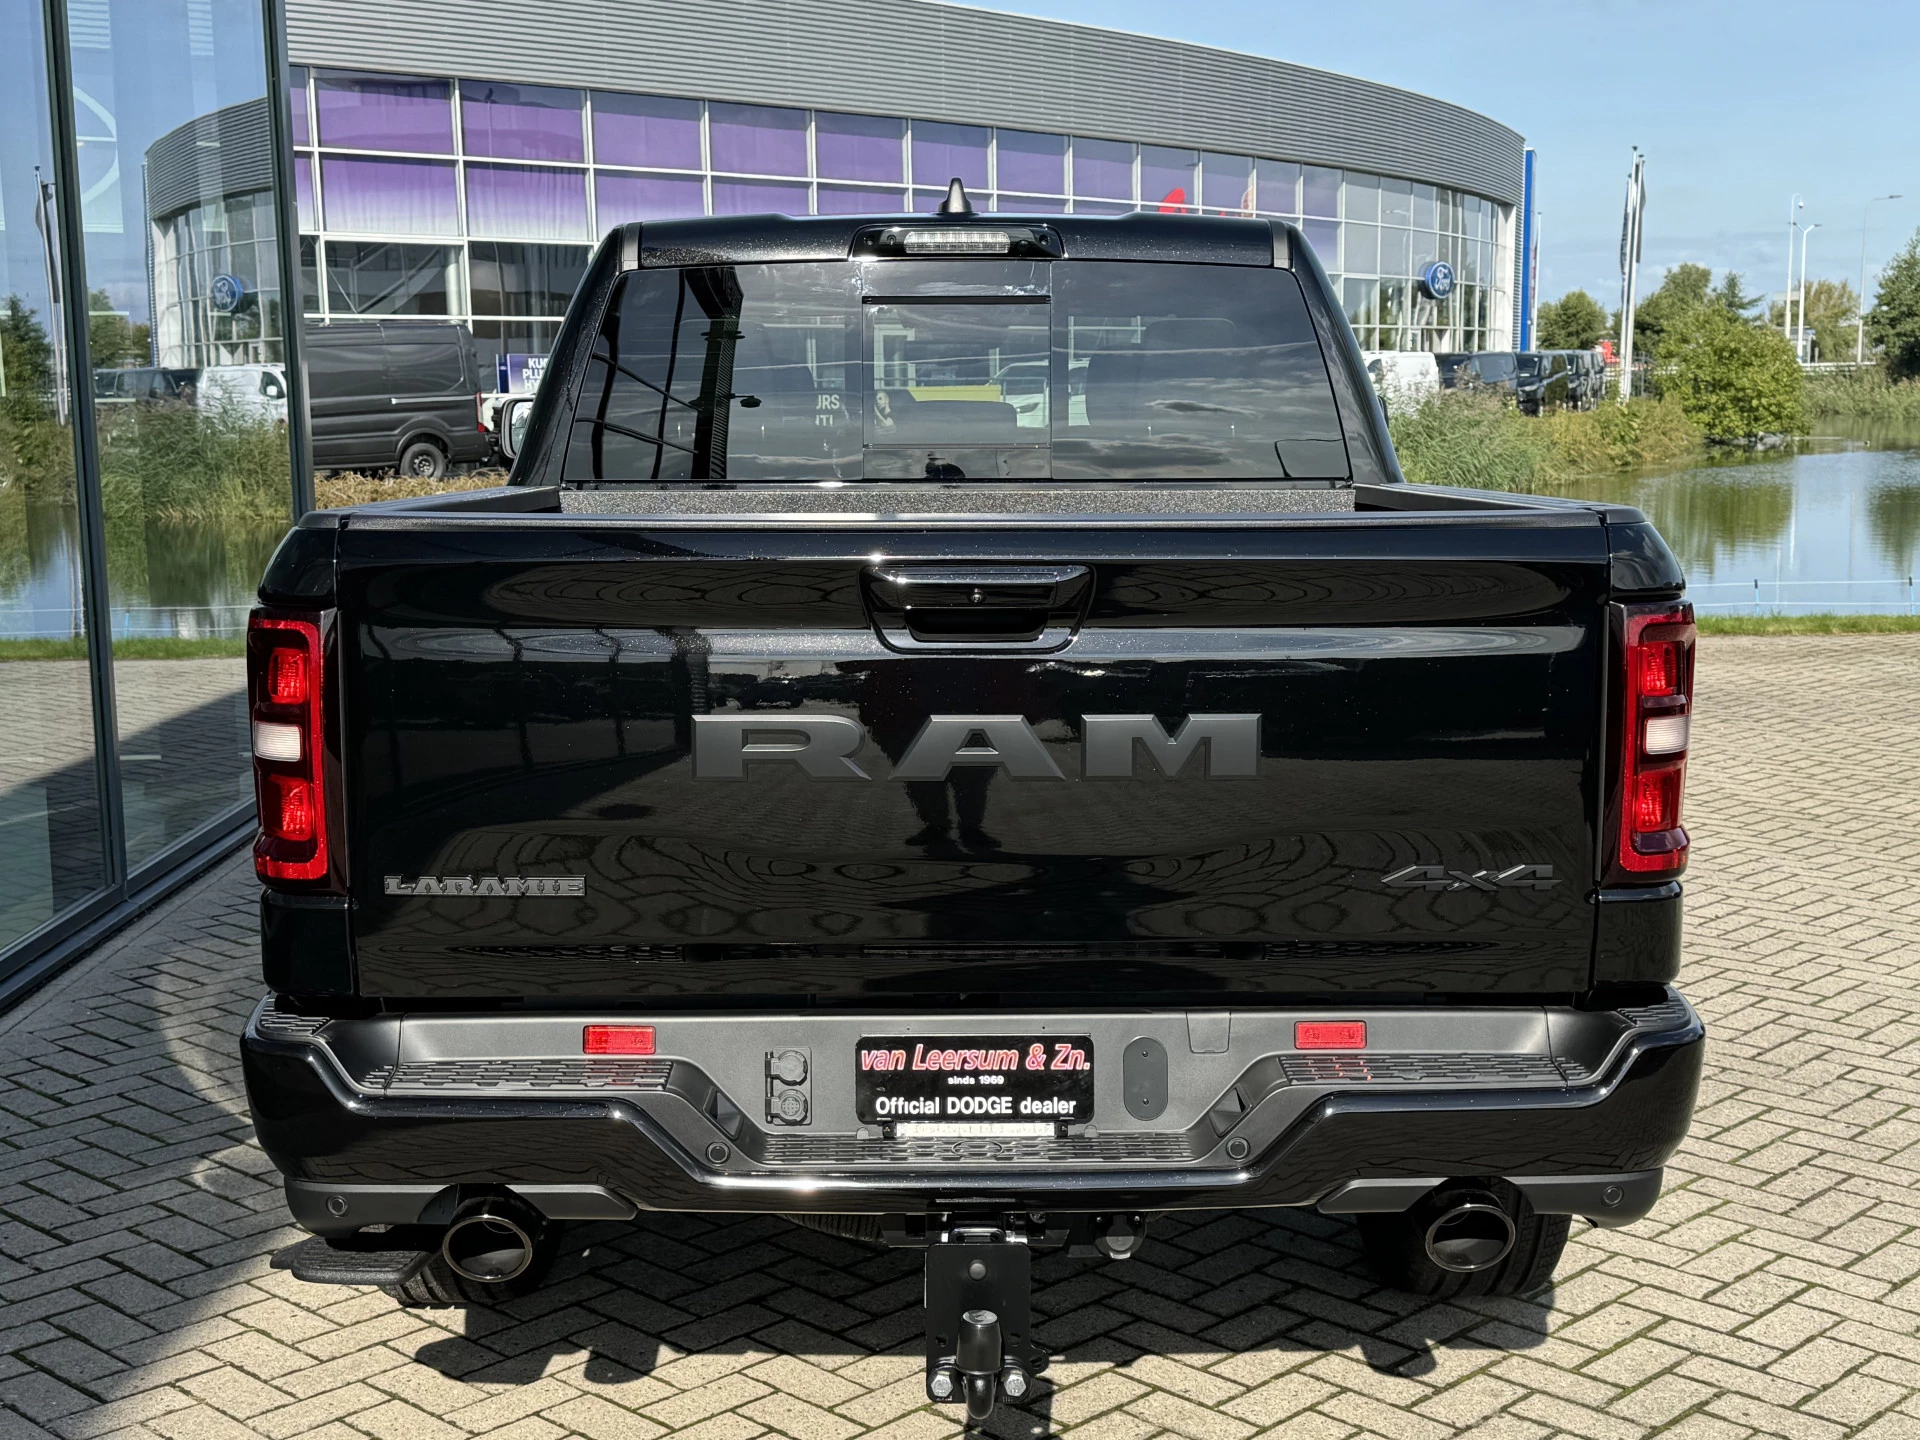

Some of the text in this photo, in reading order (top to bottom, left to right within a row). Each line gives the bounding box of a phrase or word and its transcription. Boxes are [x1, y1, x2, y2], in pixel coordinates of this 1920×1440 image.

[691, 714, 1262, 781] RAM
[384, 875, 586, 896] LARAMIE
[860, 1043, 1091, 1070] van Leersum & Zn.
[948, 1076, 1004, 1085] sinds 1969
[875, 1097, 1076, 1114] Official DODGE dealer
